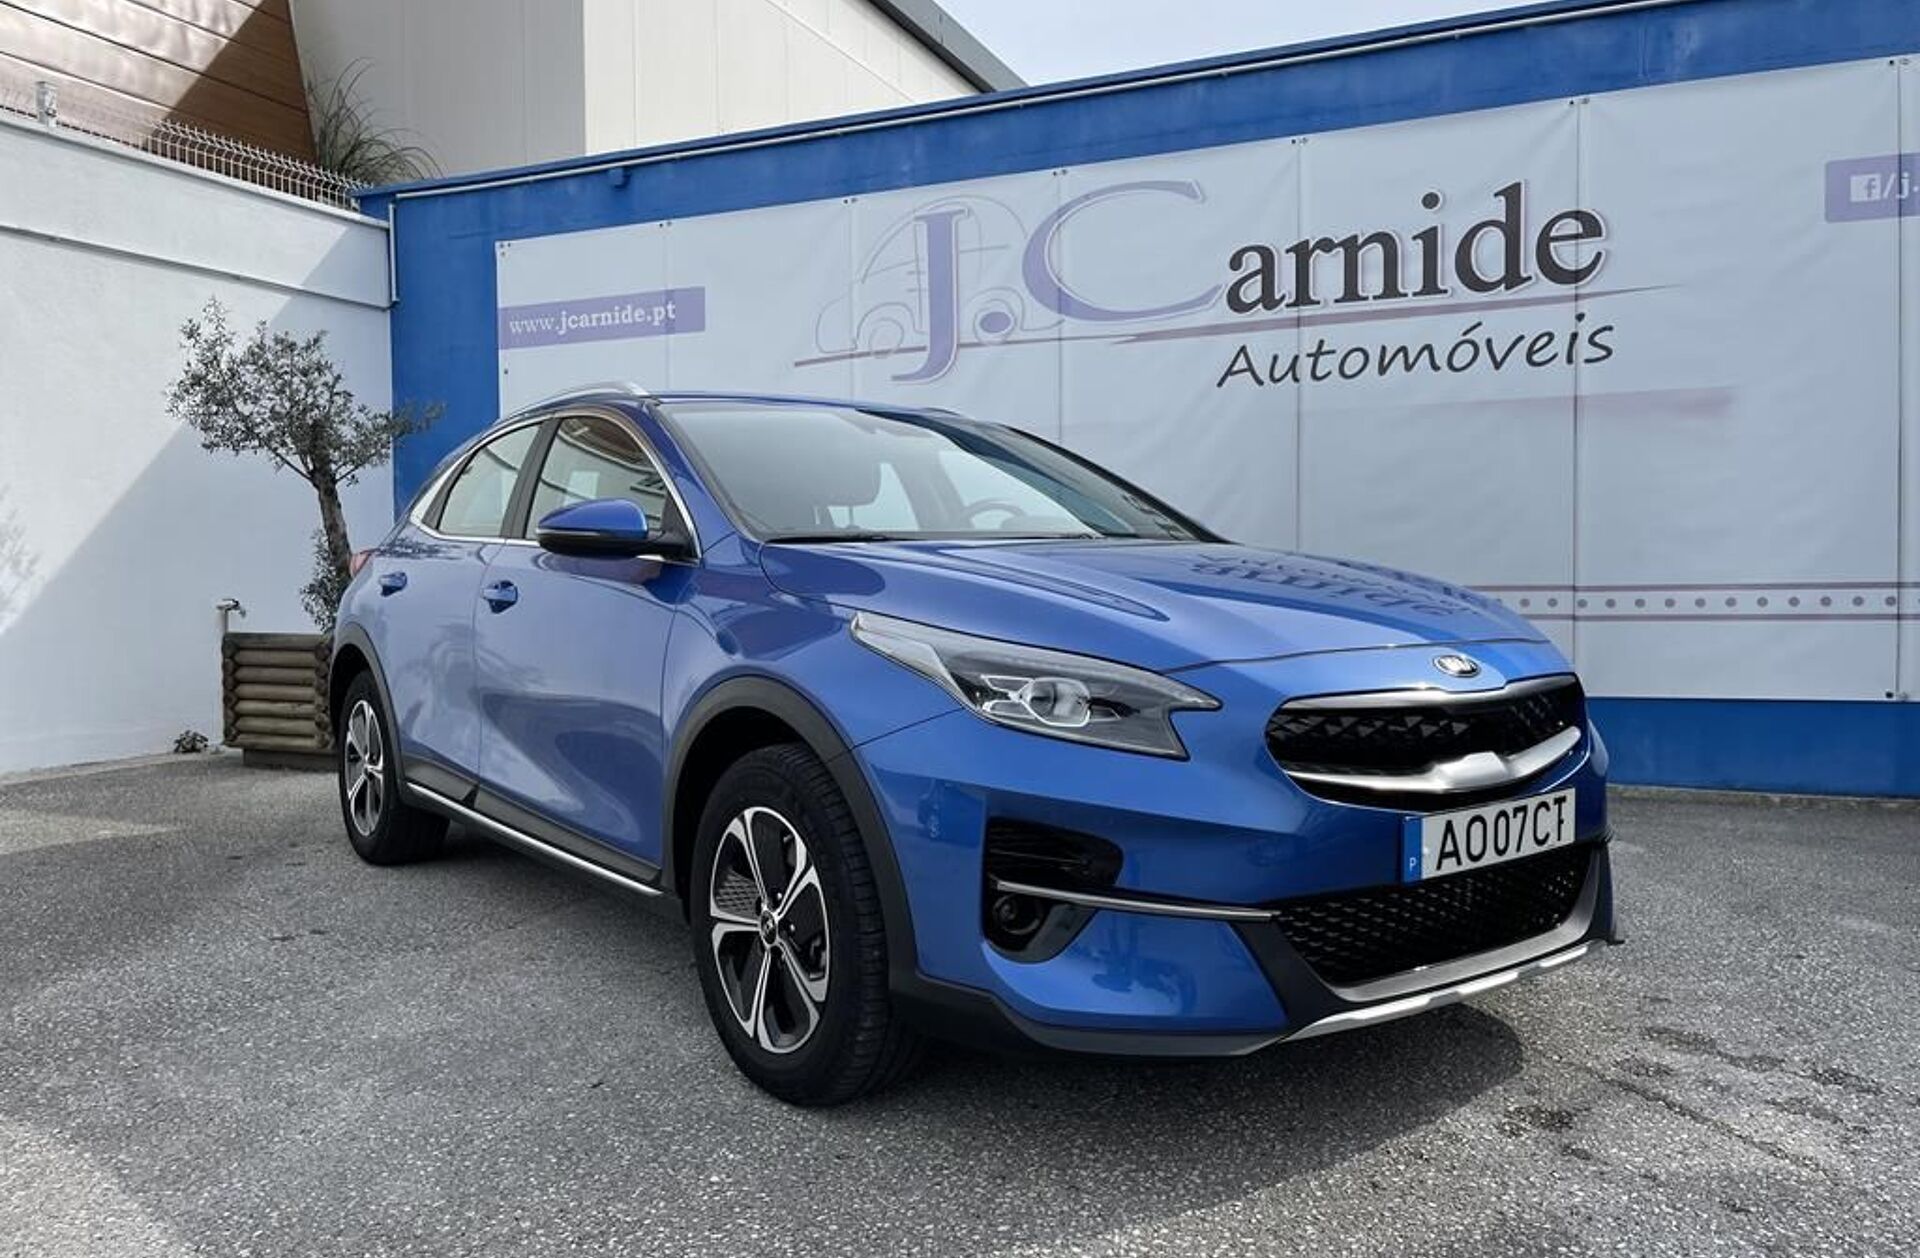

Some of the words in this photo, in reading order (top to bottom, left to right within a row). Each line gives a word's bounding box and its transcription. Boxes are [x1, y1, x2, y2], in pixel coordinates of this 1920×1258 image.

[890, 180, 1606, 382] J.Carnide
[509, 301, 676, 335] www.jcarnide.pt
[1216, 314, 1615, 387] Automóveis
[1409, 857, 1417, 871] P
[1436, 795, 1567, 871] AO07CT
